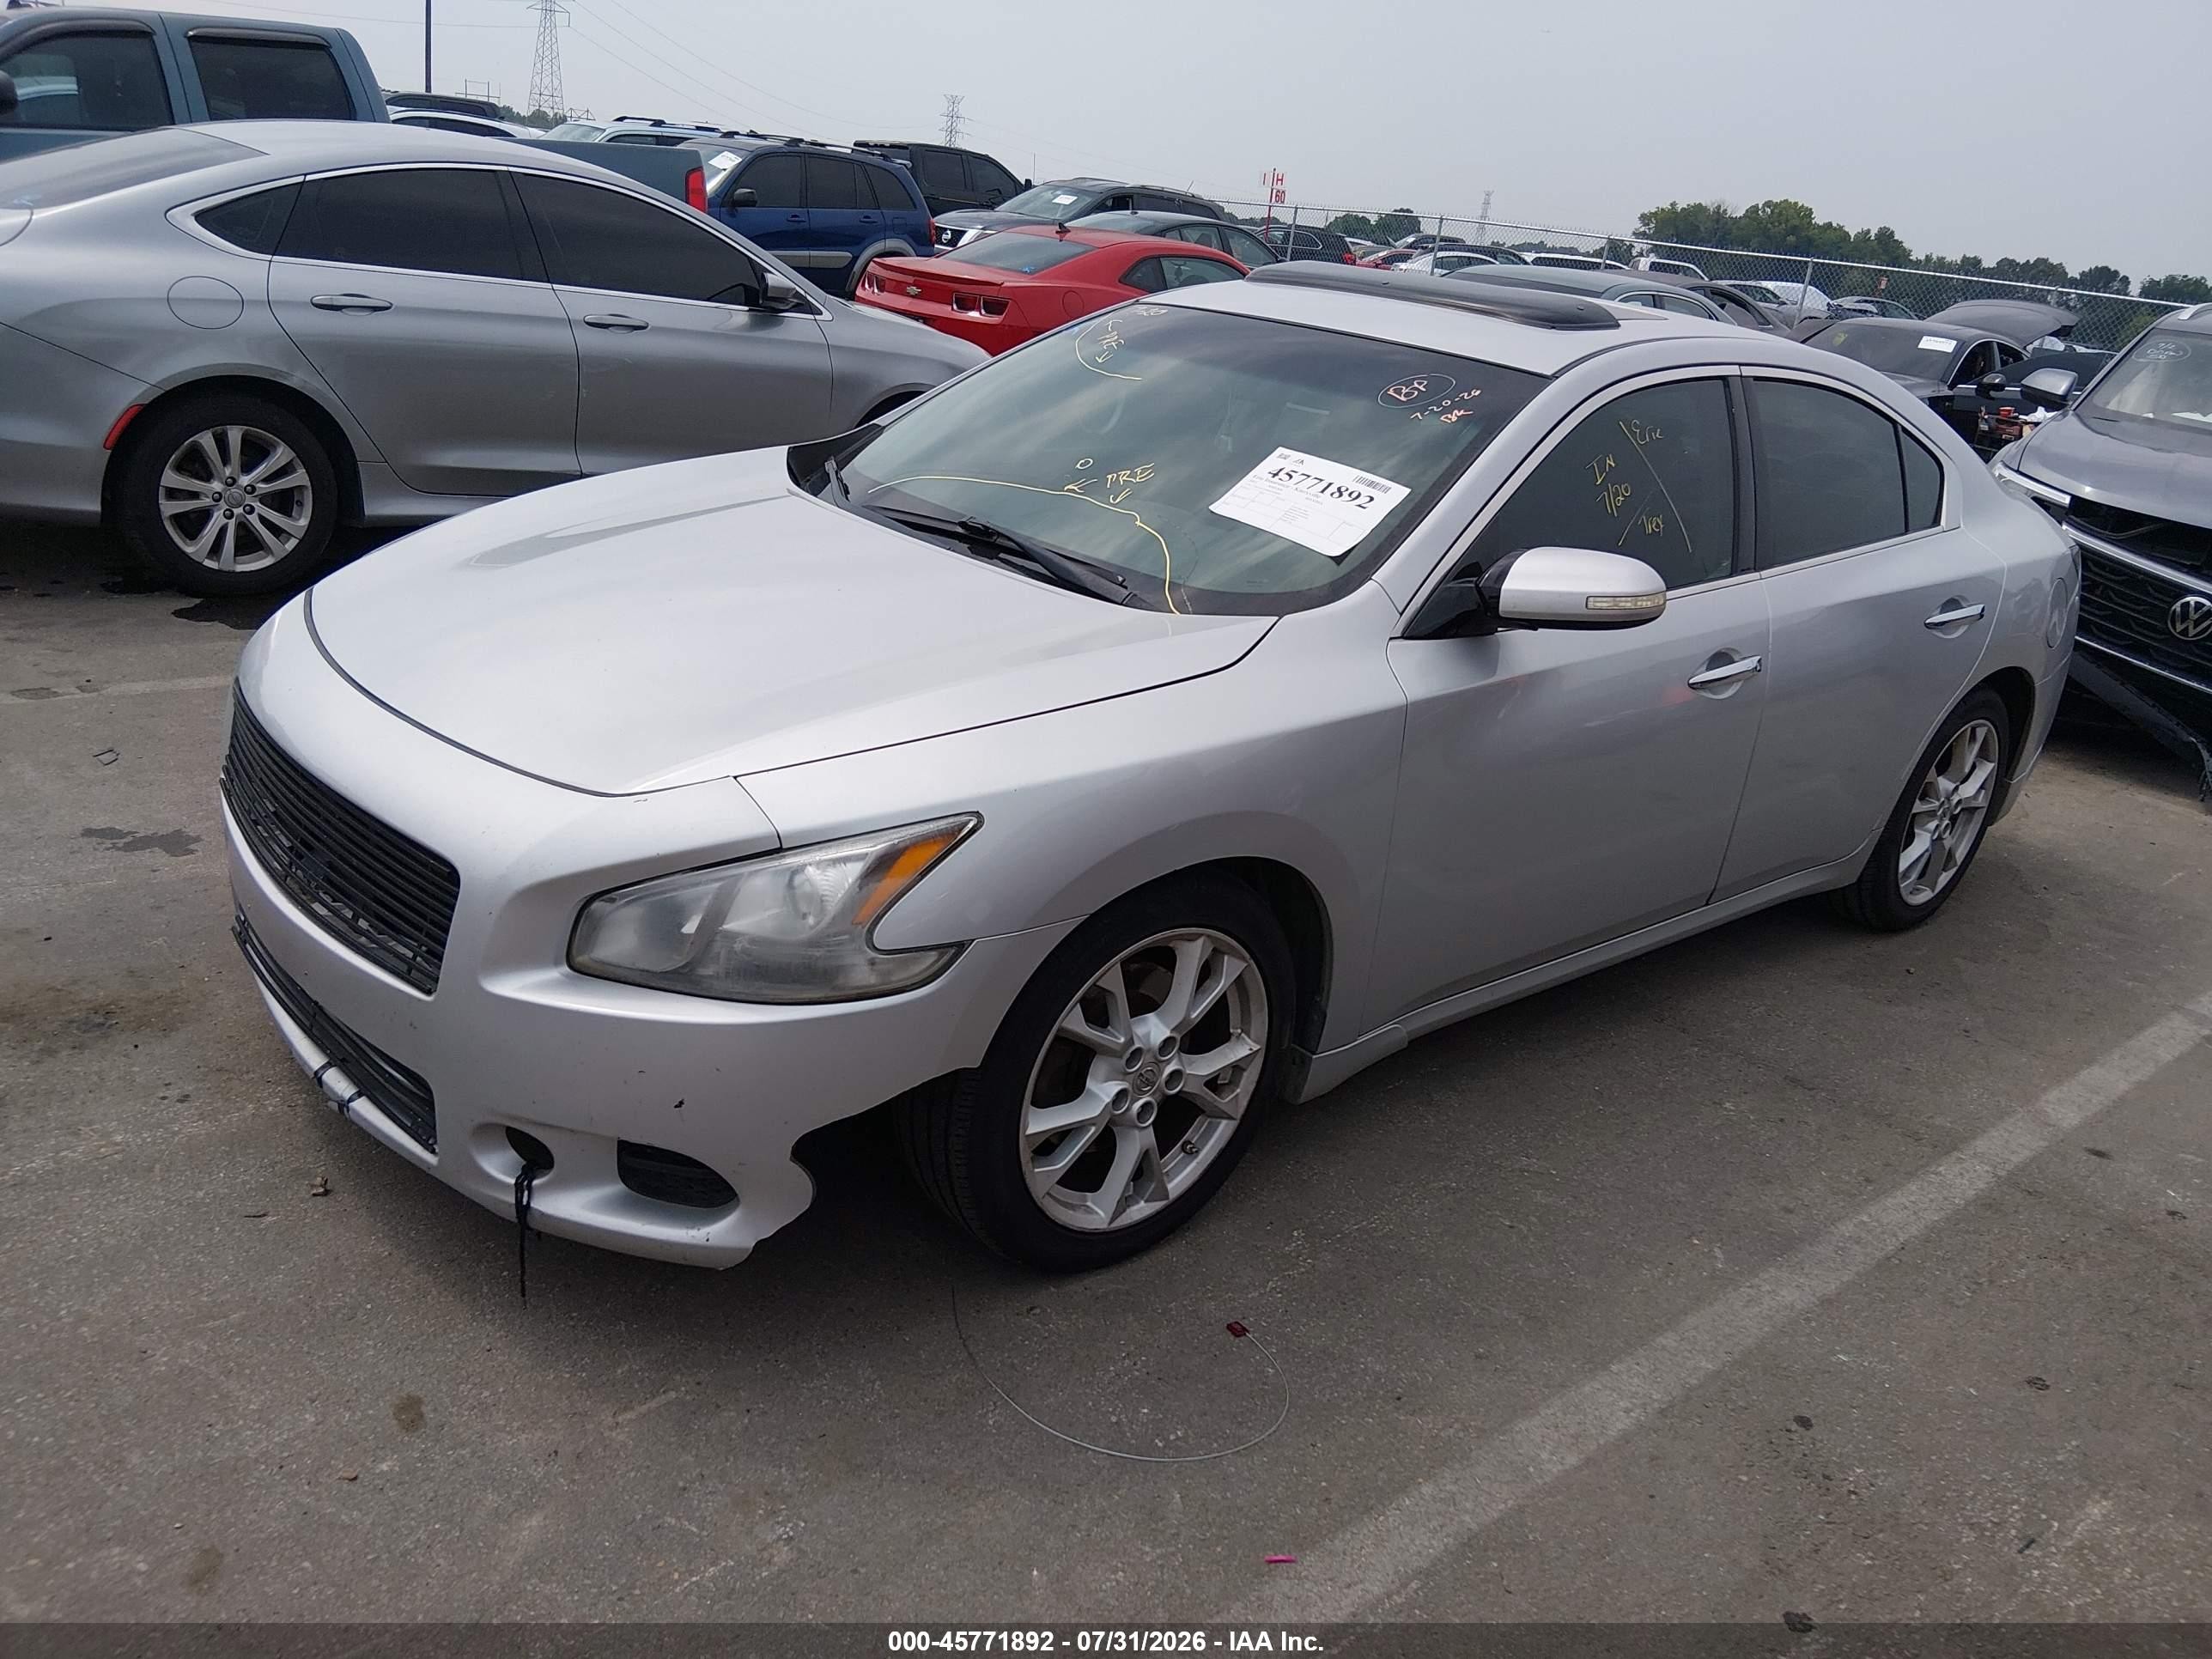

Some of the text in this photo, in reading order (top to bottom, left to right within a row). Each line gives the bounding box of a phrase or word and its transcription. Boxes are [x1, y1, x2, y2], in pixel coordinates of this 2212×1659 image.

[1276, 173, 1284, 185] H
[1275, 190, 1285, 204] 60
[1106, 462, 1155, 489] PRE
[1267, 466, 1376, 510] 45771892
[1595, 483, 1632, 517] 7/20
